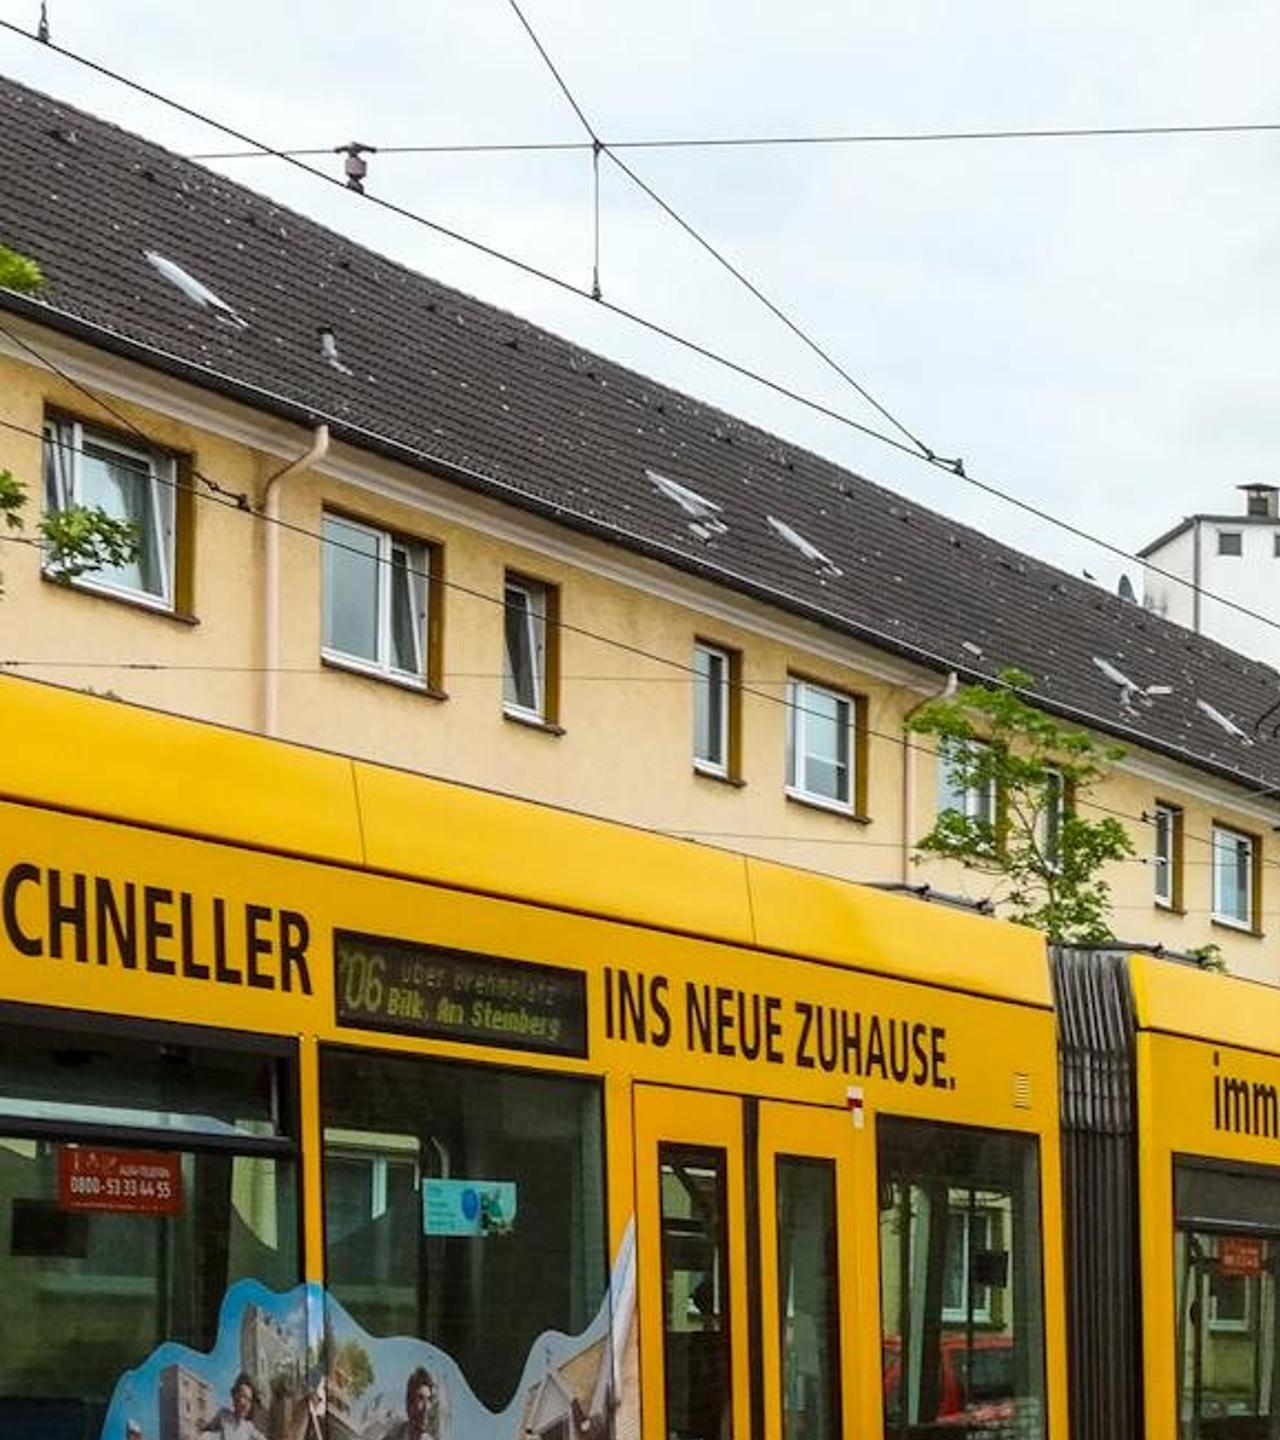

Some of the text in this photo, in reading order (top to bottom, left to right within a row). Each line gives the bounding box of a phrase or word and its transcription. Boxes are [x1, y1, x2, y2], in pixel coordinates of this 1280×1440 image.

[3, 862, 313, 995] CHNELLER
[604, 966, 956, 1090] INS NEUE ZUHAUSE.
